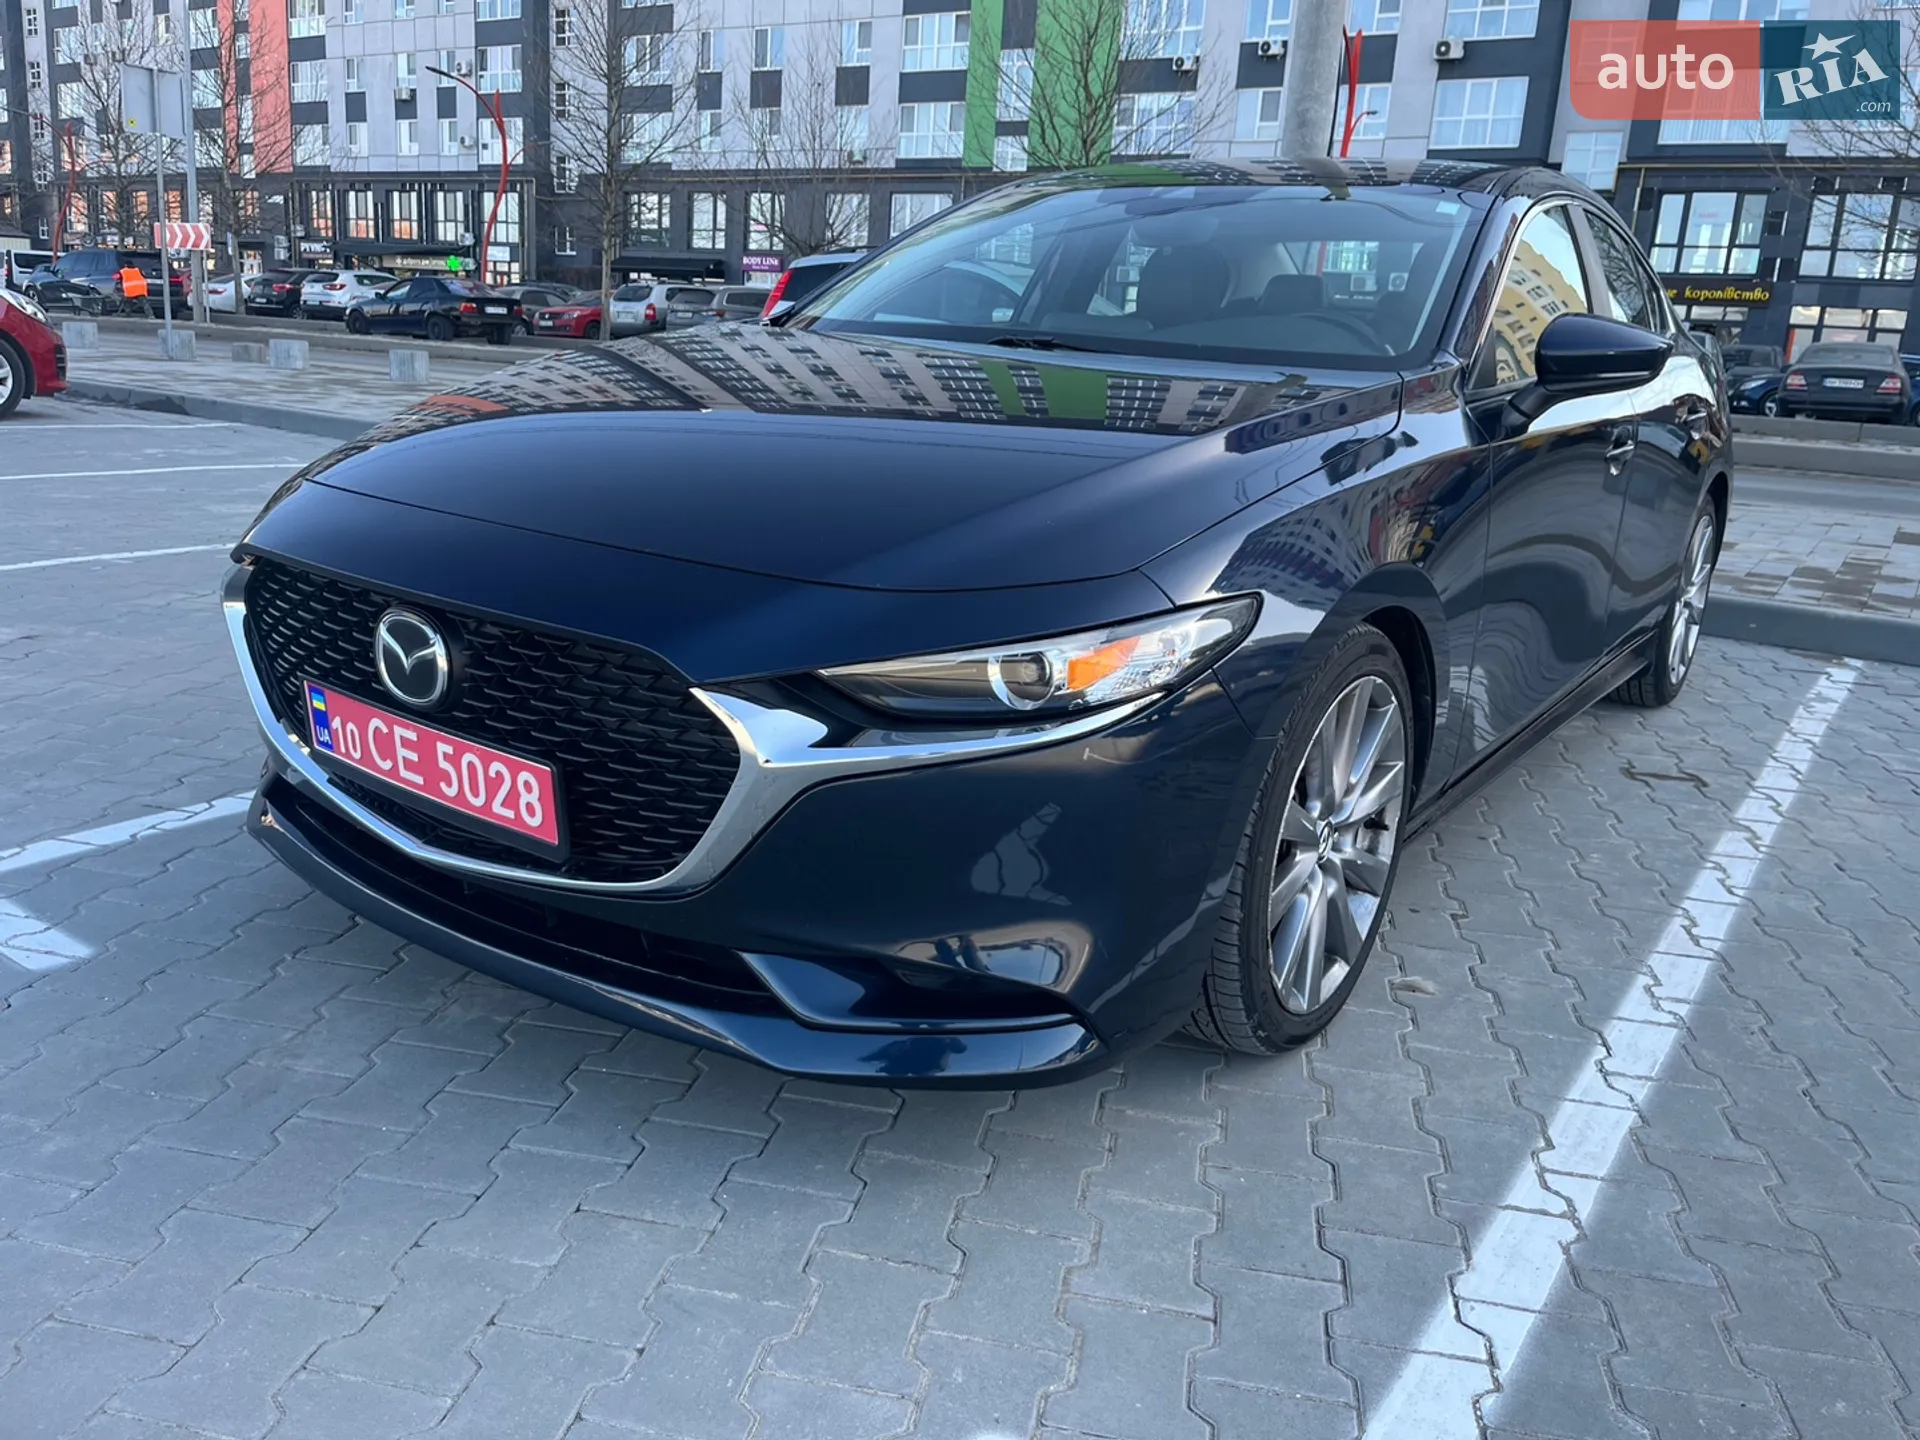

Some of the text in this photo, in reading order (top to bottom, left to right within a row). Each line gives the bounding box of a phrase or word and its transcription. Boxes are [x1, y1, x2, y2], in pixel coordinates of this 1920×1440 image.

[743, 256, 778, 265] BODY LINE
[316, 727, 332, 745] UA
[331, 715, 543, 828] 10 CE 5028
